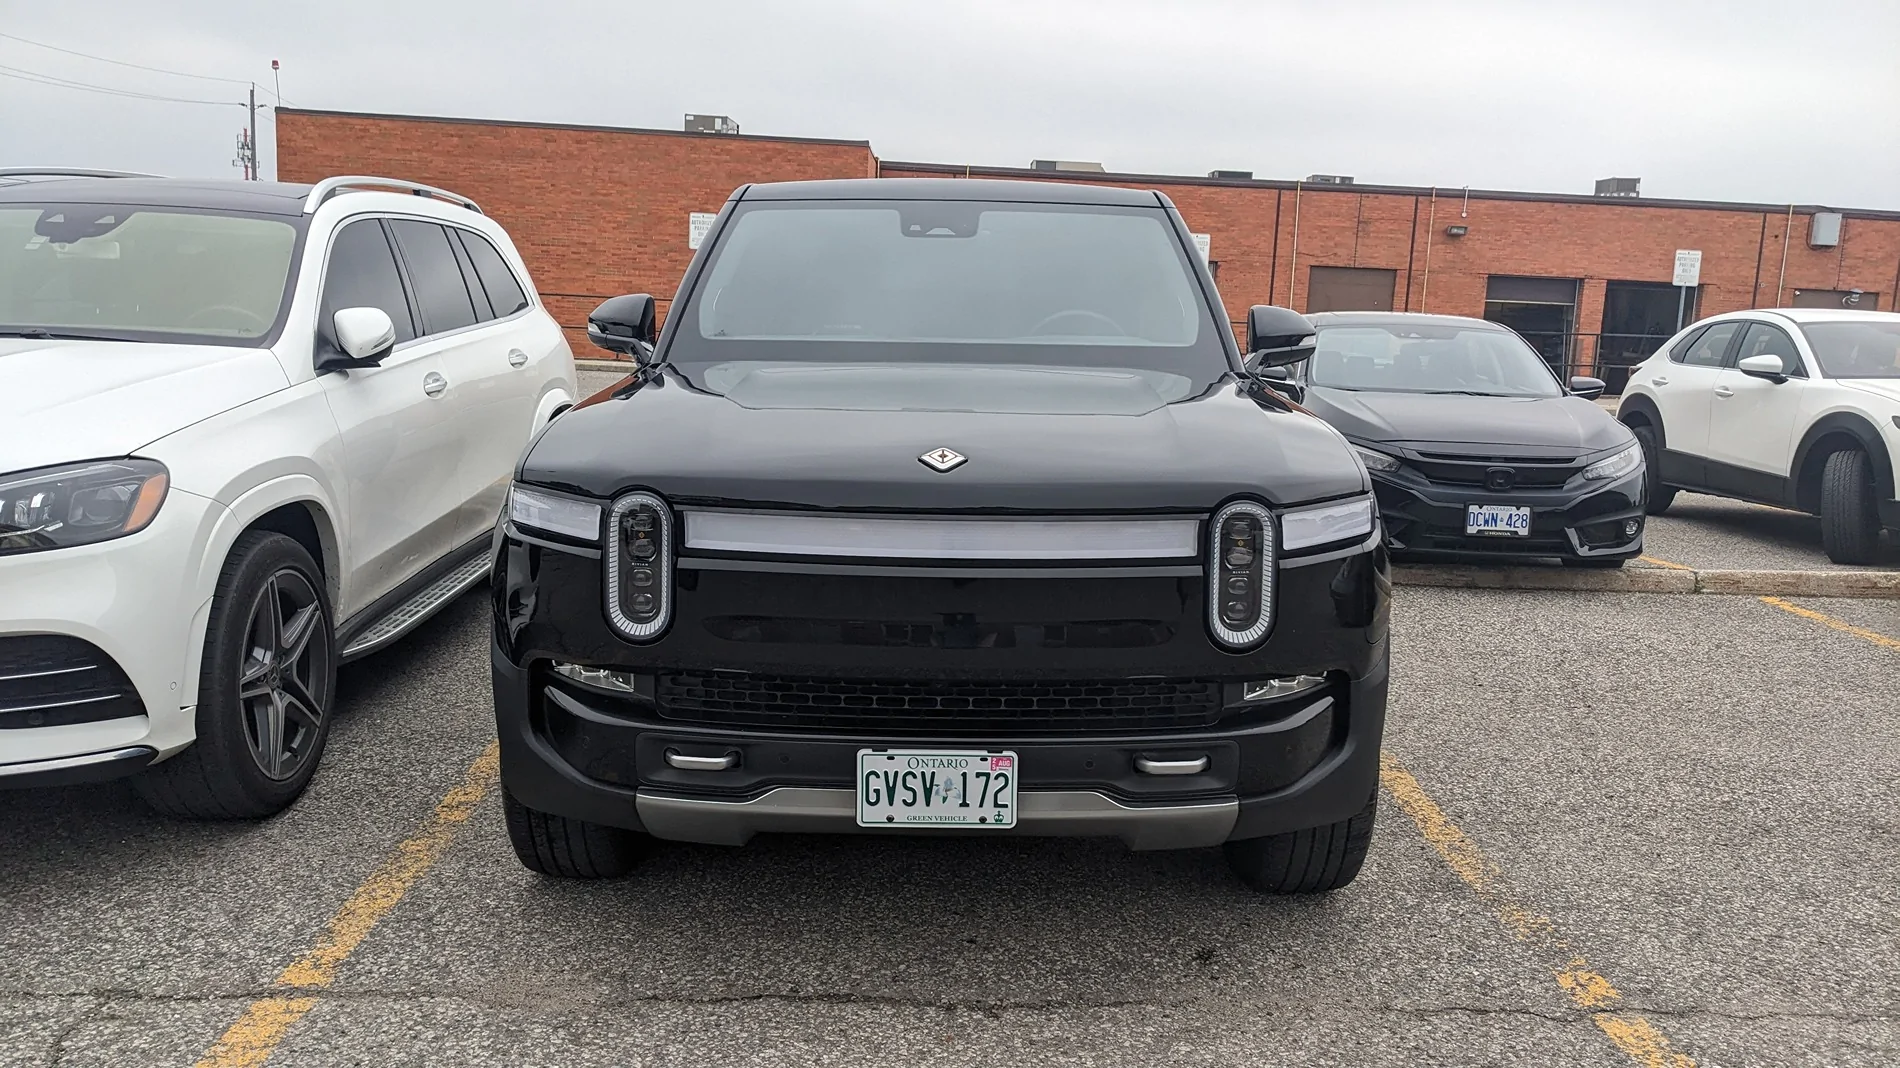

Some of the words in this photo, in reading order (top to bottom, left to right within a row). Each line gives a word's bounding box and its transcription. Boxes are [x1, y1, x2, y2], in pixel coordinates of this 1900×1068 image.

[1468, 512, 1498, 527] DCWN
[1505, 513, 1529, 528] 428
[907, 757, 969, 770] ONTARIO
[865, 770, 936, 807] GVSV
[959, 771, 1010, 808] 172
